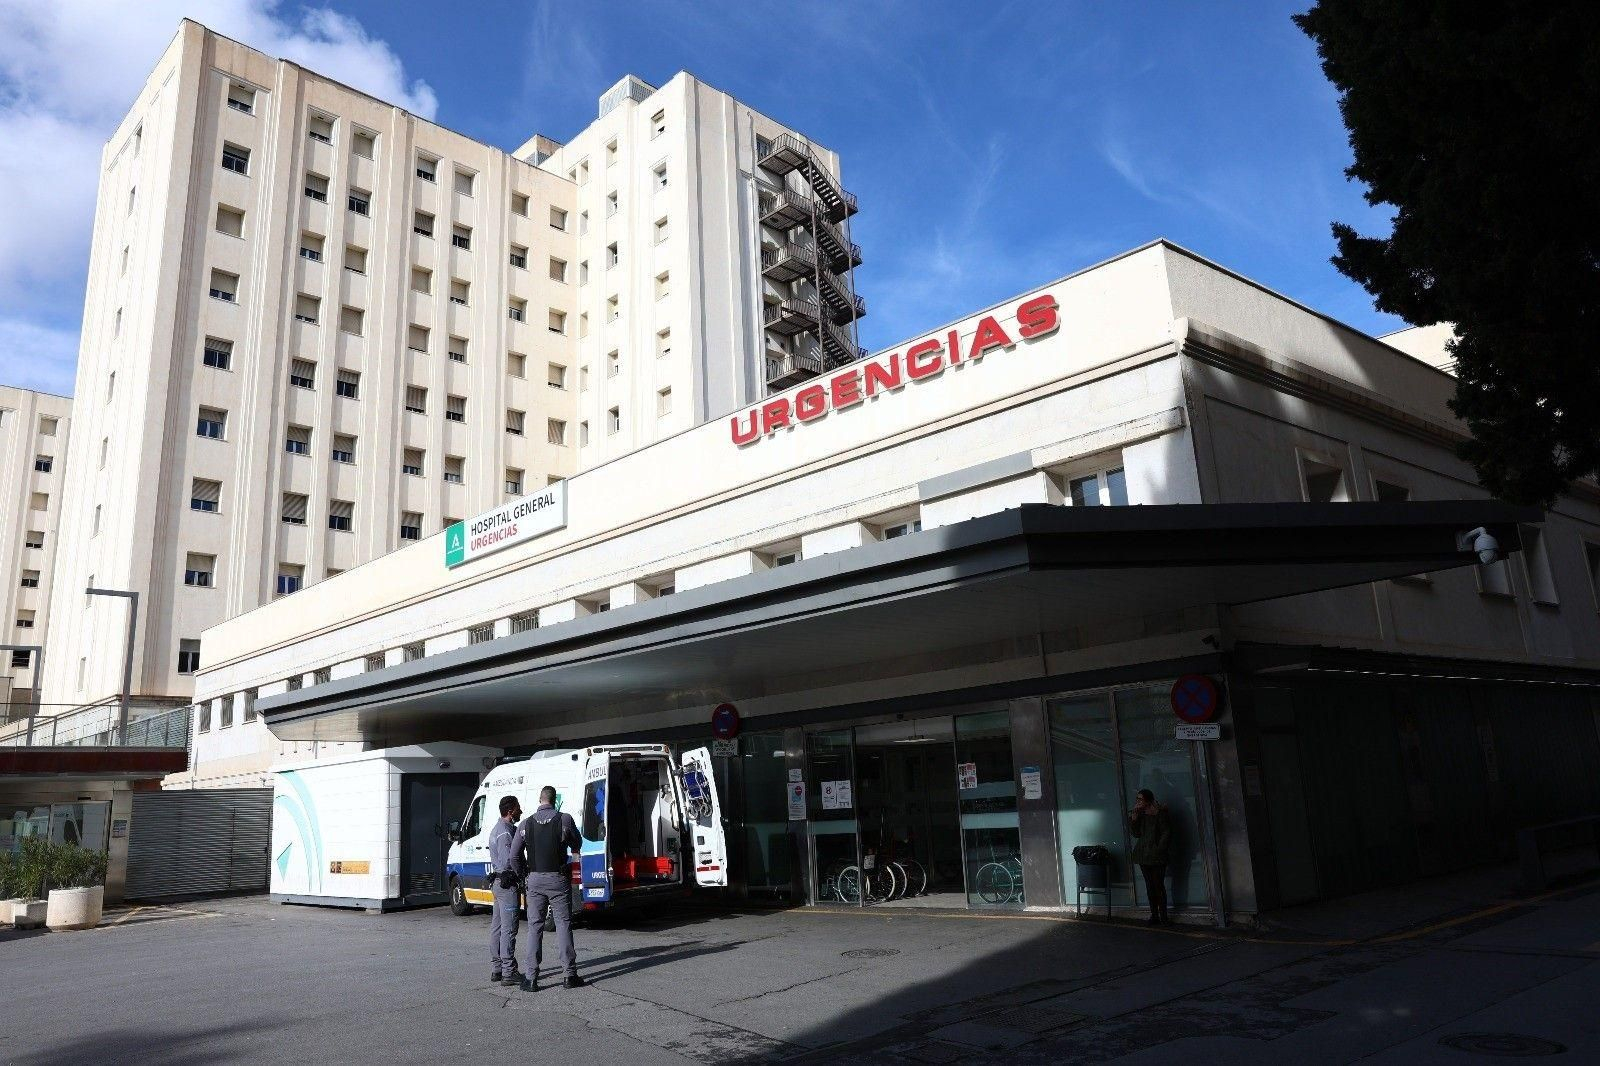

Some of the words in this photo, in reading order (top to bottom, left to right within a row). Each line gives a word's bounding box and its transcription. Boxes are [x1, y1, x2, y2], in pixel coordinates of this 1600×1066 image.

[730, 293, 1061, 446] URGENCIAS
[471, 510, 512, 536] HOSPITAL
[513, 492, 556, 519] GENERAL
[470, 523, 518, 551] URGENCIAS
